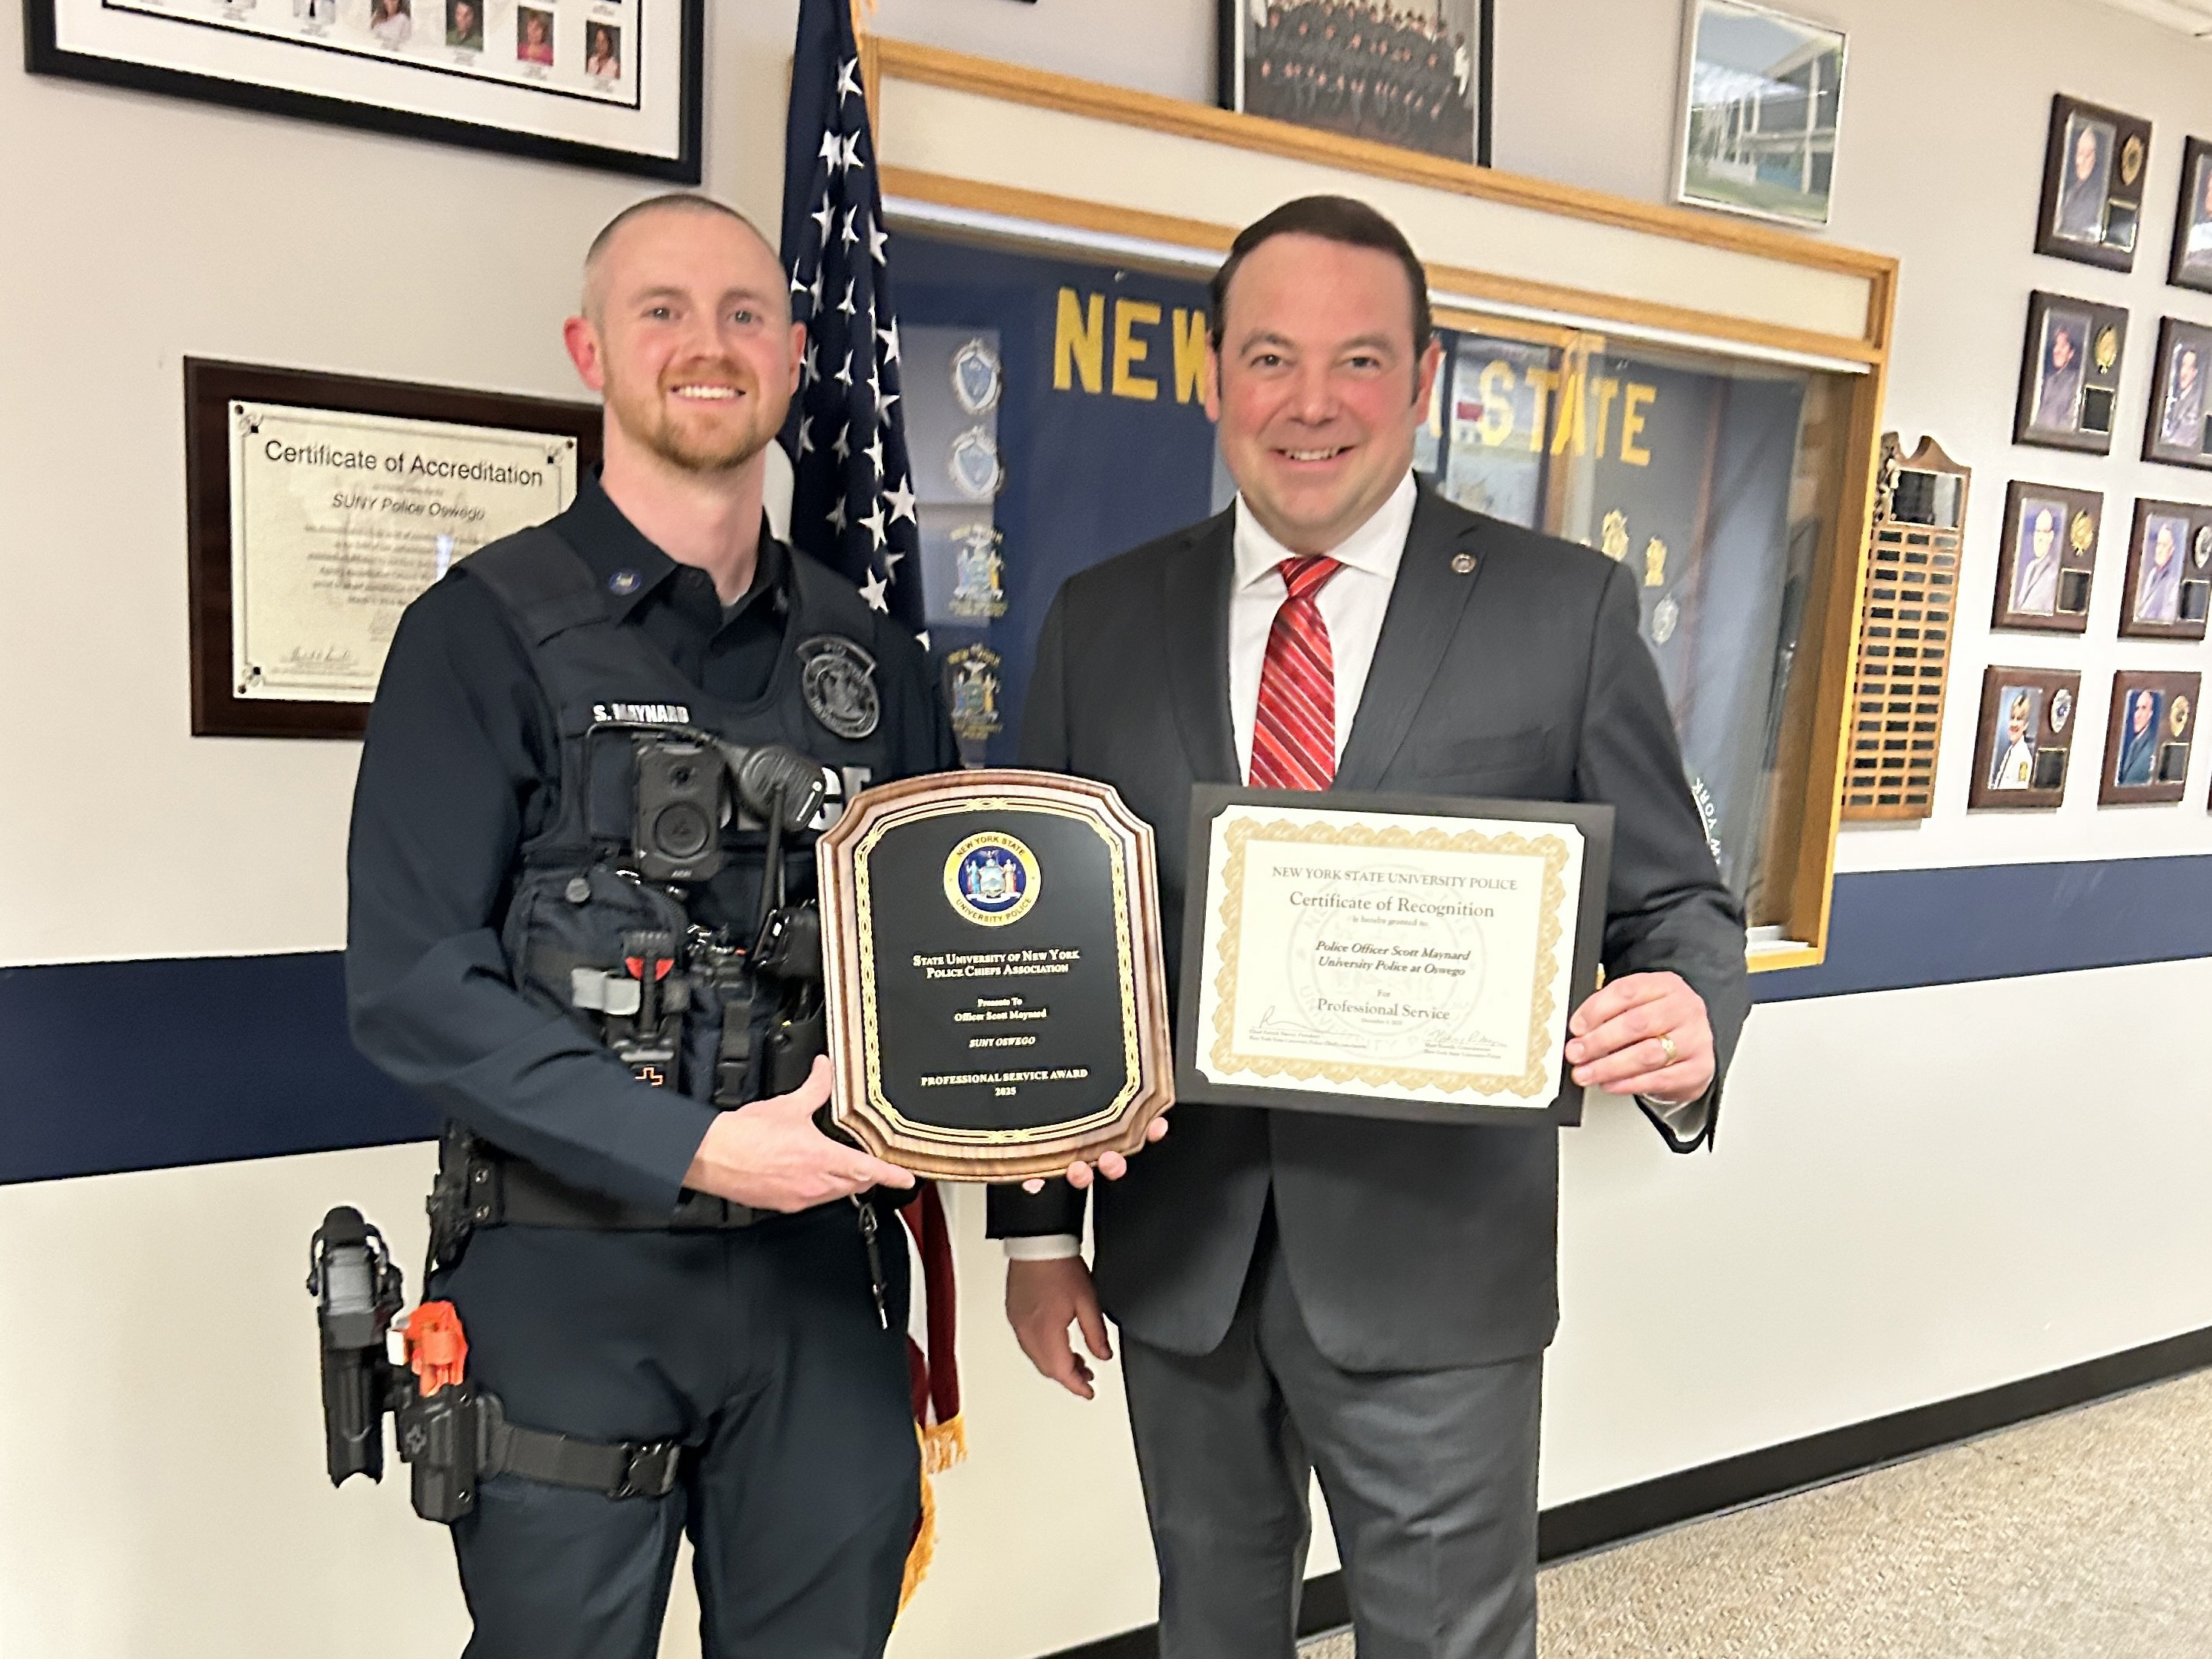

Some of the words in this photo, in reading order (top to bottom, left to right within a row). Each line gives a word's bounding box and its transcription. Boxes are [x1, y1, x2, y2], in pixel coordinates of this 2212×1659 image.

[1053, 286, 1208, 405] NEW
[1479, 360, 1657, 466] STATE
[266, 440, 377, 470] Certificate
[385, 453, 404, 473] of
[410, 455, 543, 487] Accreditation
[332, 493, 377, 511] SUNY
[381, 497, 424, 516] Police
[428, 502, 486, 523] Oswego
[593, 704, 612, 722] S.
[956, 841, 973, 857] NEW
[975, 836, 999, 844] YORK
[1002, 838, 1025, 856] STATE
[1272, 866, 1303, 878] NEW
[1306, 868, 1342, 880] YORK
[1344, 870, 1385, 882] STATE
[1388, 872, 1467, 888] UNIVERSITY
[1469, 877, 1517, 890] POLICE
[956, 899, 1003, 922] UNIVERSITY
[1005, 898, 1032, 920] POLICE
[1290, 891, 1372, 910] Certificate
[1376, 895, 1395, 912] of
[1398, 897, 1494, 918] Recognition
[913, 955, 944, 967] STATE
[946, 953, 1006, 965] UNIVERSITY
[1022, 951, 1048, 961] NEW
[1048, 949, 1081, 960] YORK
[1316, 940, 1348, 952] Police
[1352, 942, 1389, 956] Officer
[1391, 945, 1418, 957] Scott
[1421, 948, 1472, 961] Maynard
[926, 967, 963, 979] POLICE
[965, 965, 1002, 977] CHIEFS
[1003, 964, 1069, 975] ASSOCIATION
[1318, 956, 1373, 971] University
[1375, 960, 1408, 972] Police
[1410, 965, 1421, 973] at
[1424, 964, 1466, 977] Oswego
[1377, 989, 1391, 998] For
[954, 1012, 985, 1022] Officer
[985, 1011, 1008, 1021] Scott
[1009, 1008, 1047, 1021] Maynard
[1318, 998, 1398, 1017] Professional
[1401, 1004, 1450, 1021] Service
[969, 1038, 995, 1048] SUNY
[995, 1036, 1036, 1047] OSWEGO
[921, 1073, 1002, 1087] PROFESSIONAL
[1002, 1071, 1048, 1082] SERVICE
[1050, 1069, 1088, 1080] AWARD
